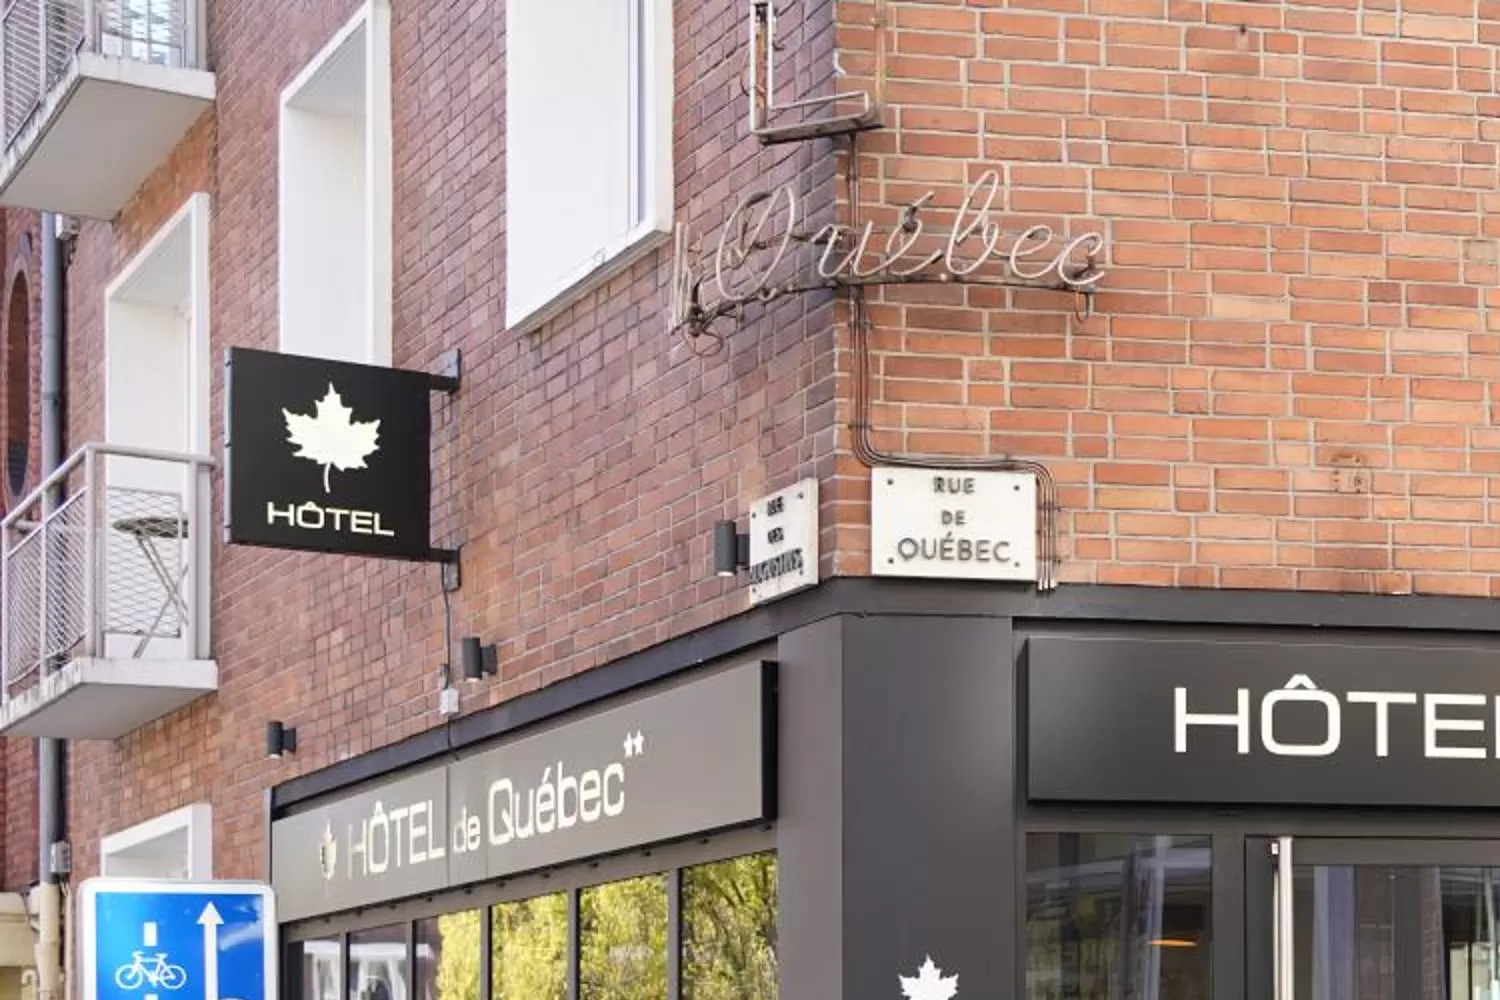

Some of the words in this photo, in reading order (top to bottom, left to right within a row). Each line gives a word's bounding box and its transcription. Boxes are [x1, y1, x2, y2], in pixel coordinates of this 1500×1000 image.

[933, 477, 976, 495] RUE
[266, 501, 395, 537] HÔTEL
[941, 510, 966, 526] DE
[897, 531, 1011, 562] QUÉBEC
[348, 800, 446, 880] HÔTEL
[453, 805, 481, 854] de
[488, 761, 625, 846] Québec
